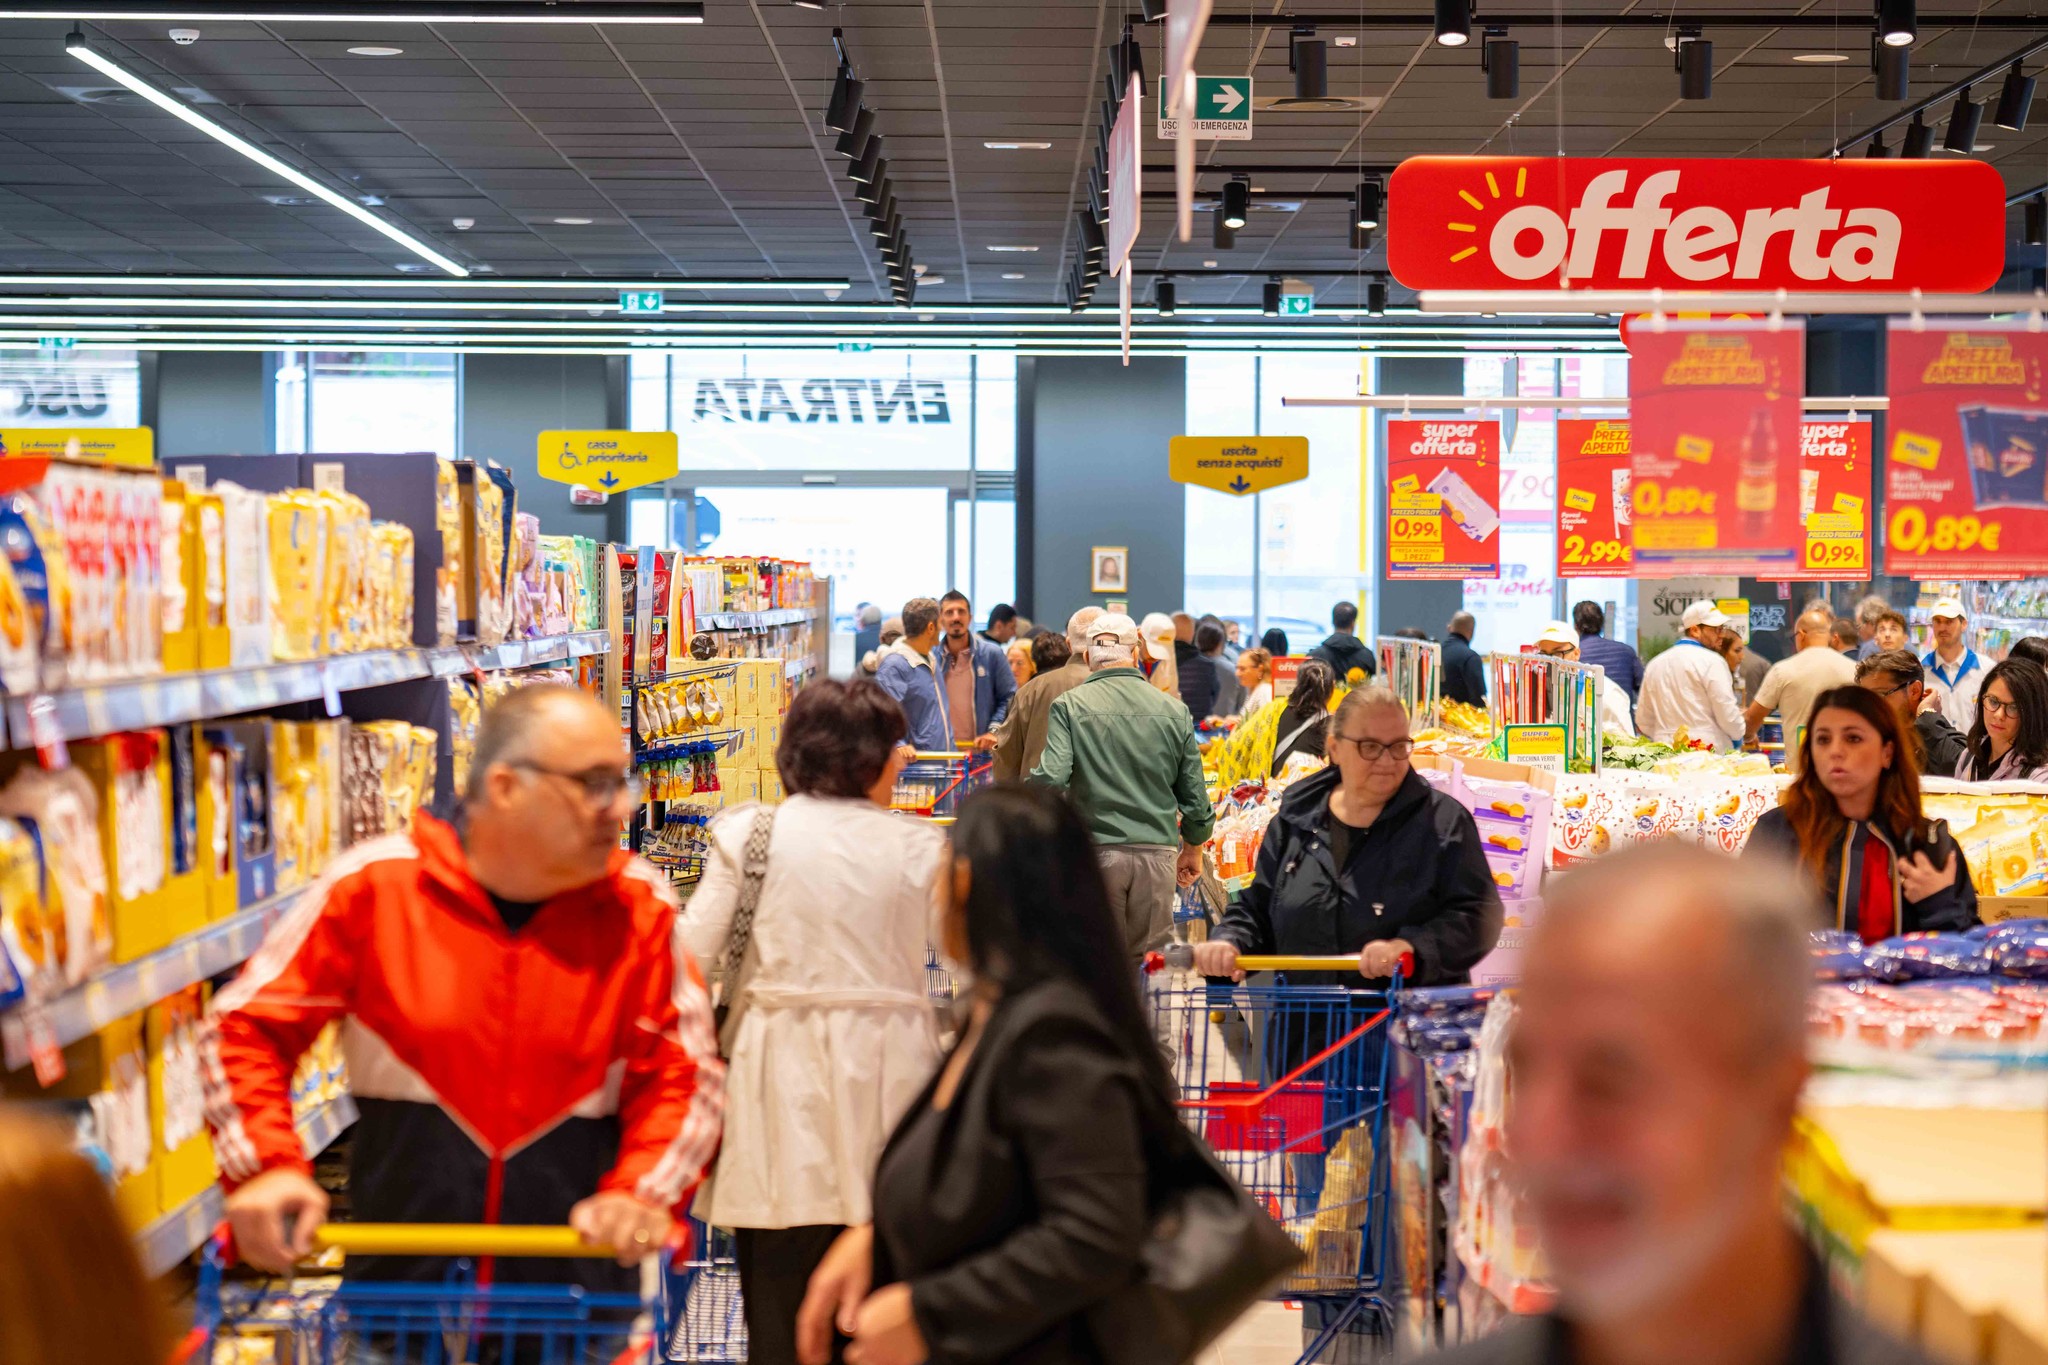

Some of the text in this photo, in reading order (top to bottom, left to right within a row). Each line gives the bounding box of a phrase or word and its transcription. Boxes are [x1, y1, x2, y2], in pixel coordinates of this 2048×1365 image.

[1162, 121, 1178, 130] USC
[1201, 121, 1248, 131] EMERGENZA
[1489, 169, 1902, 282] offerta
[1422, 424, 1478, 442] super
[1801, 424, 1849, 443] uper
[587, 441, 617, 449] cassa
[1222, 445, 1257, 456] uscita
[1410, 437, 1476, 455] offerta
[1582, 441, 1631, 453] APERTU
[1800, 438, 1847, 456] ferta
[587, 452, 648, 465] prioritaria
[1197, 457, 1283, 470] senza acquisti
[1633, 480, 1717, 520] 0,89€
[1394, 518, 1439, 539] 0,99€
[1889, 505, 2001, 556] 0,89€
[1562, 534, 1632, 566] 2,99€
[1810, 542, 1860, 565] 0,99€
